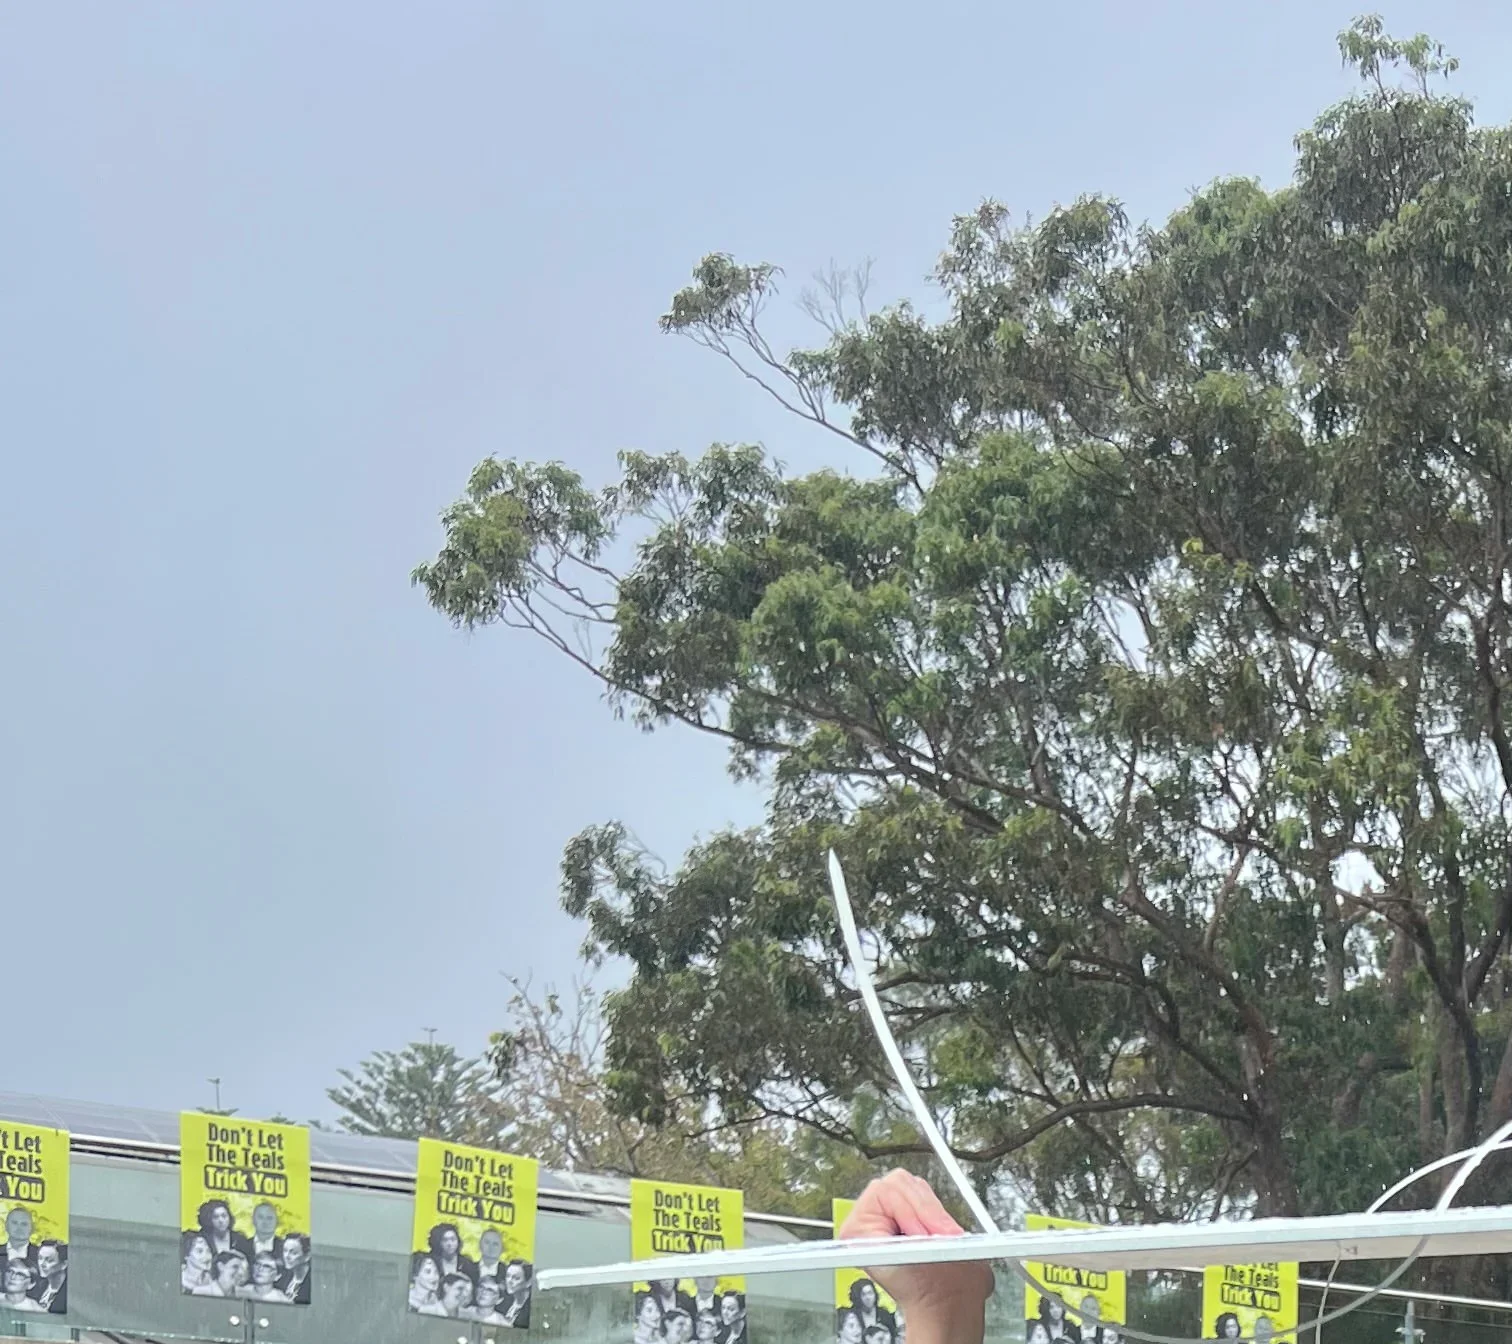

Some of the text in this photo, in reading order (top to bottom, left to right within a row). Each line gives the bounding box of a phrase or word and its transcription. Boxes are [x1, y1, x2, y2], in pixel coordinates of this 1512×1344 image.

[14, 1131, 41, 1154] Let
[208, 1122, 283, 1150] Don't Let
[206, 1143, 285, 1170] The Teals
[444, 1150, 513, 1180] Don't Let
[6, 1175, 42, 1200] You
[206, 1168, 286, 1196] Trick You
[441, 1170, 513, 1199] The Teals
[440, 1192, 513, 1223] Trick You
[654, 1190, 720, 1213] Don't Let
[653, 1209, 721, 1232] The Teals
[654, 1230, 723, 1253] Trick You
[1045, 1264, 1105, 1289] Trick You
[1224, 1265, 1279, 1288] The Teals
[1222, 1284, 1280, 1310] Trick You
